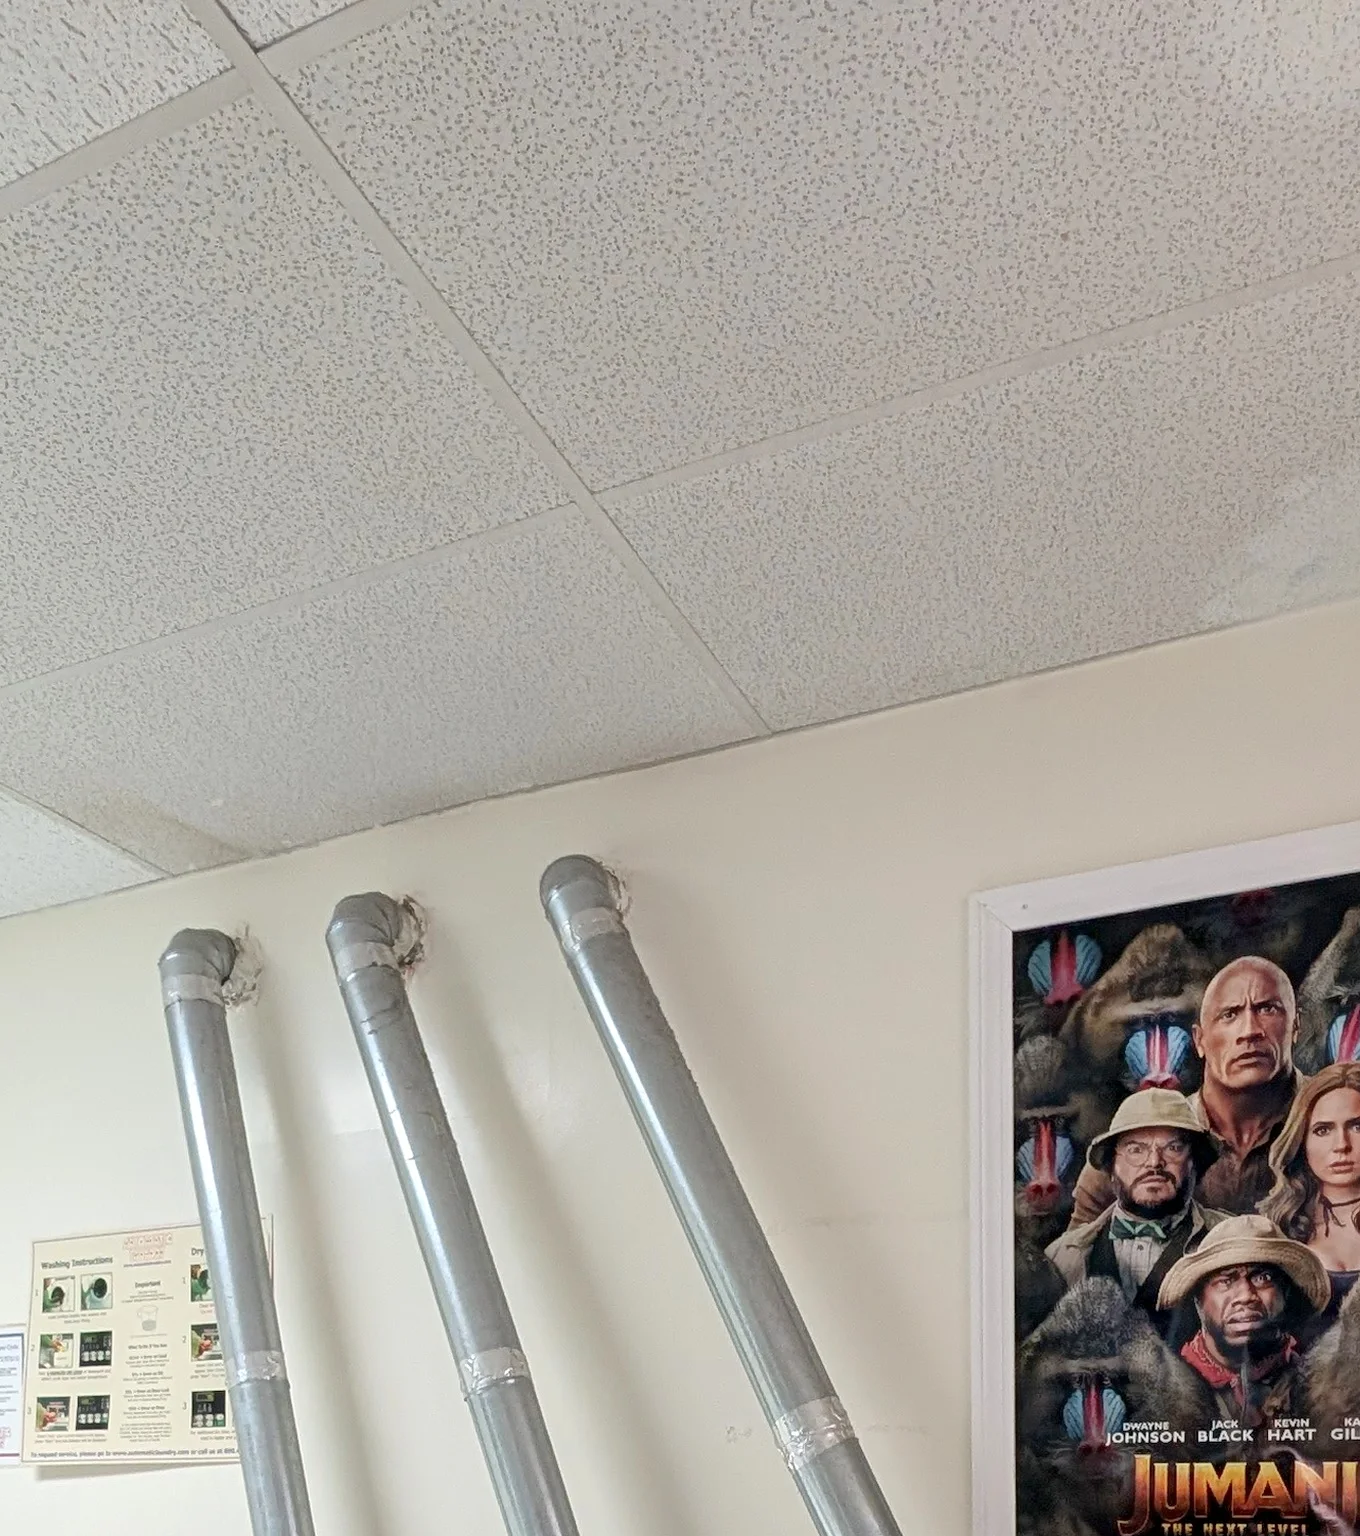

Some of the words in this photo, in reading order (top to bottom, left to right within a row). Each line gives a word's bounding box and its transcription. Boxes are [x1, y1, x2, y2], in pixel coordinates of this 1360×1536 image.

[41, 1259, 70, 1269] Washing
[71, 1256, 113, 1267] Instructions
[1122, 1421, 1169, 1432] DWAYNE
[1211, 1420, 1239, 1431] JACK
[1274, 1418, 1310, 1429] KEVIN
[1105, 1430, 1186, 1447] JOHNSON
[1197, 1429, 1254, 1443] BLACK
[1267, 1428, 1317, 1442] HART
[1161, 1522, 1193, 1536] THE
[1203, 1523, 1248, 1536] NEXT
